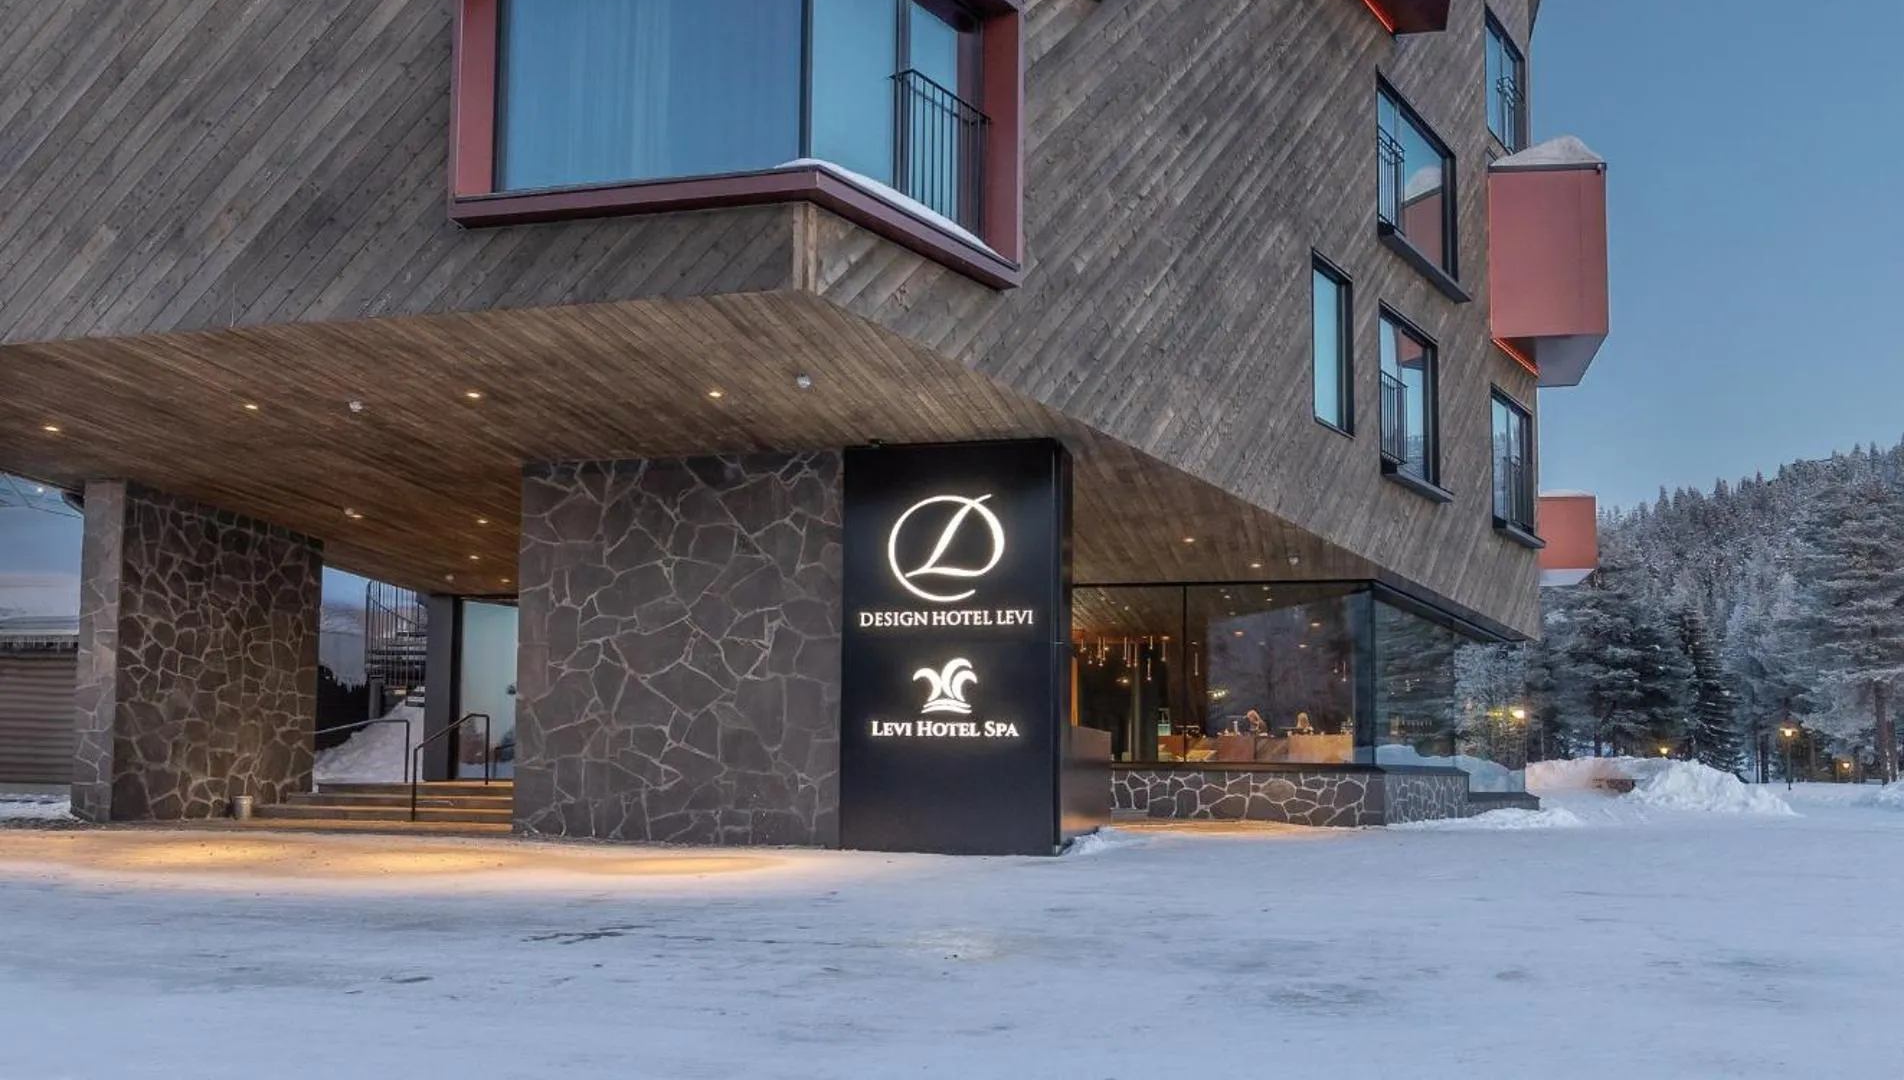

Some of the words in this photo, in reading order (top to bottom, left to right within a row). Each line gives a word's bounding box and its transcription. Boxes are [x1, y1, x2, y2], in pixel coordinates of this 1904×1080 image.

[859, 611, 928, 626] DESIGN
[931, 610, 993, 625] HOTEL
[996, 609, 1033, 625] LEVI
[871, 720, 912, 737] LEVI
[916, 720, 981, 737] HOTEL
[984, 720, 1020, 737] SPA
